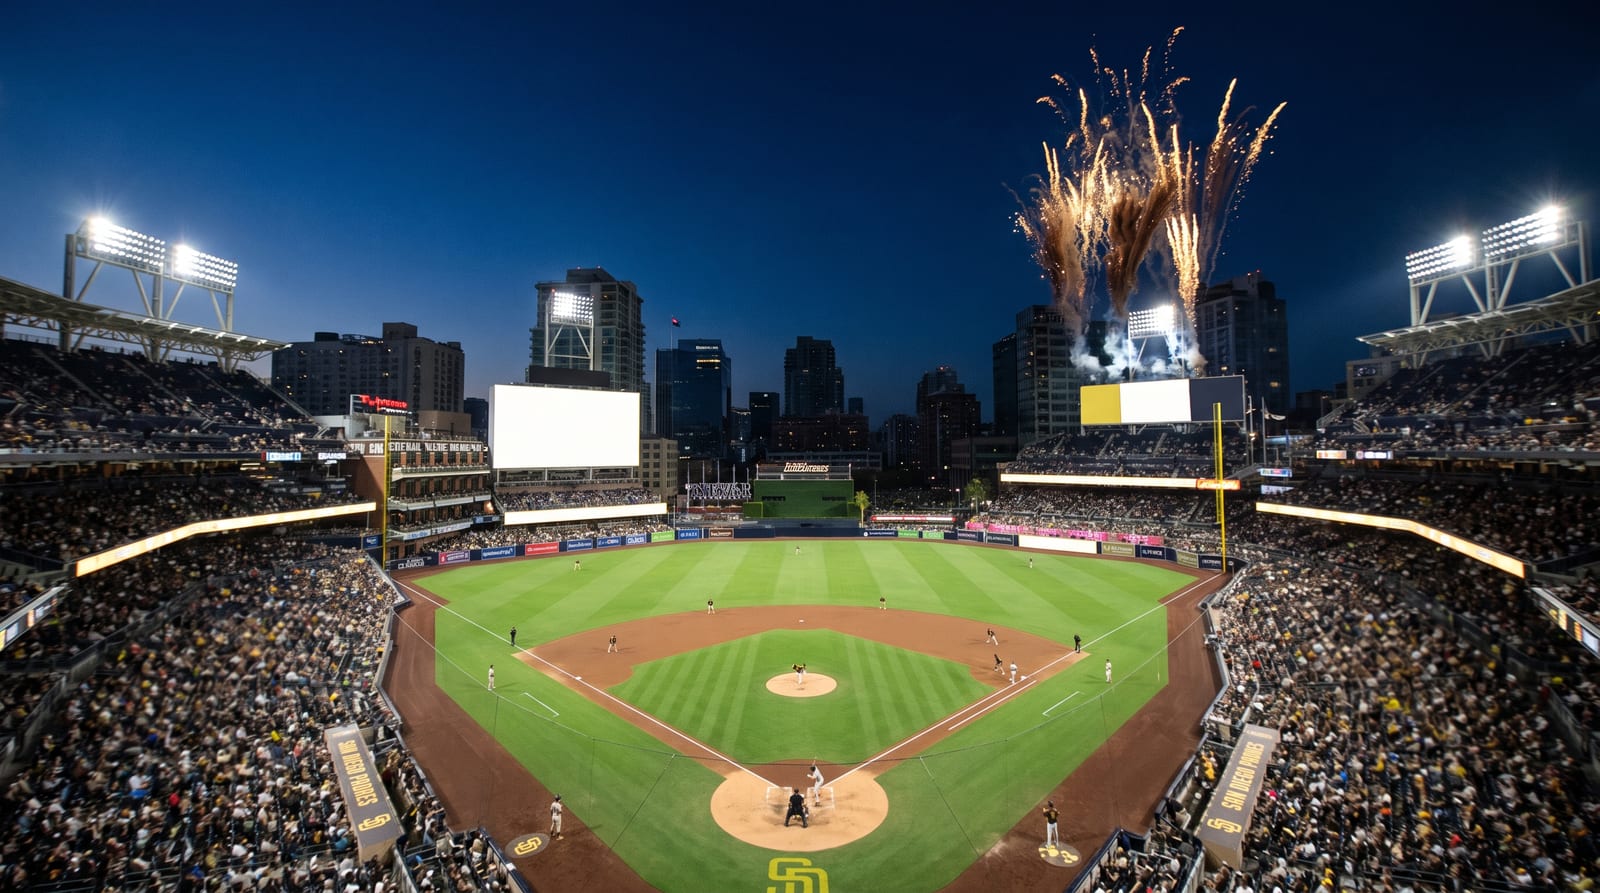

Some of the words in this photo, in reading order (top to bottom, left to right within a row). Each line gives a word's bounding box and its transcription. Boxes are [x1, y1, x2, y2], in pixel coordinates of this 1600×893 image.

[342, 752, 366, 775] DIEGO
[349, 773, 378, 807] PADRES
[1229, 766, 1256, 793] DIEGO
[1221, 789, 1247, 811] SAN
